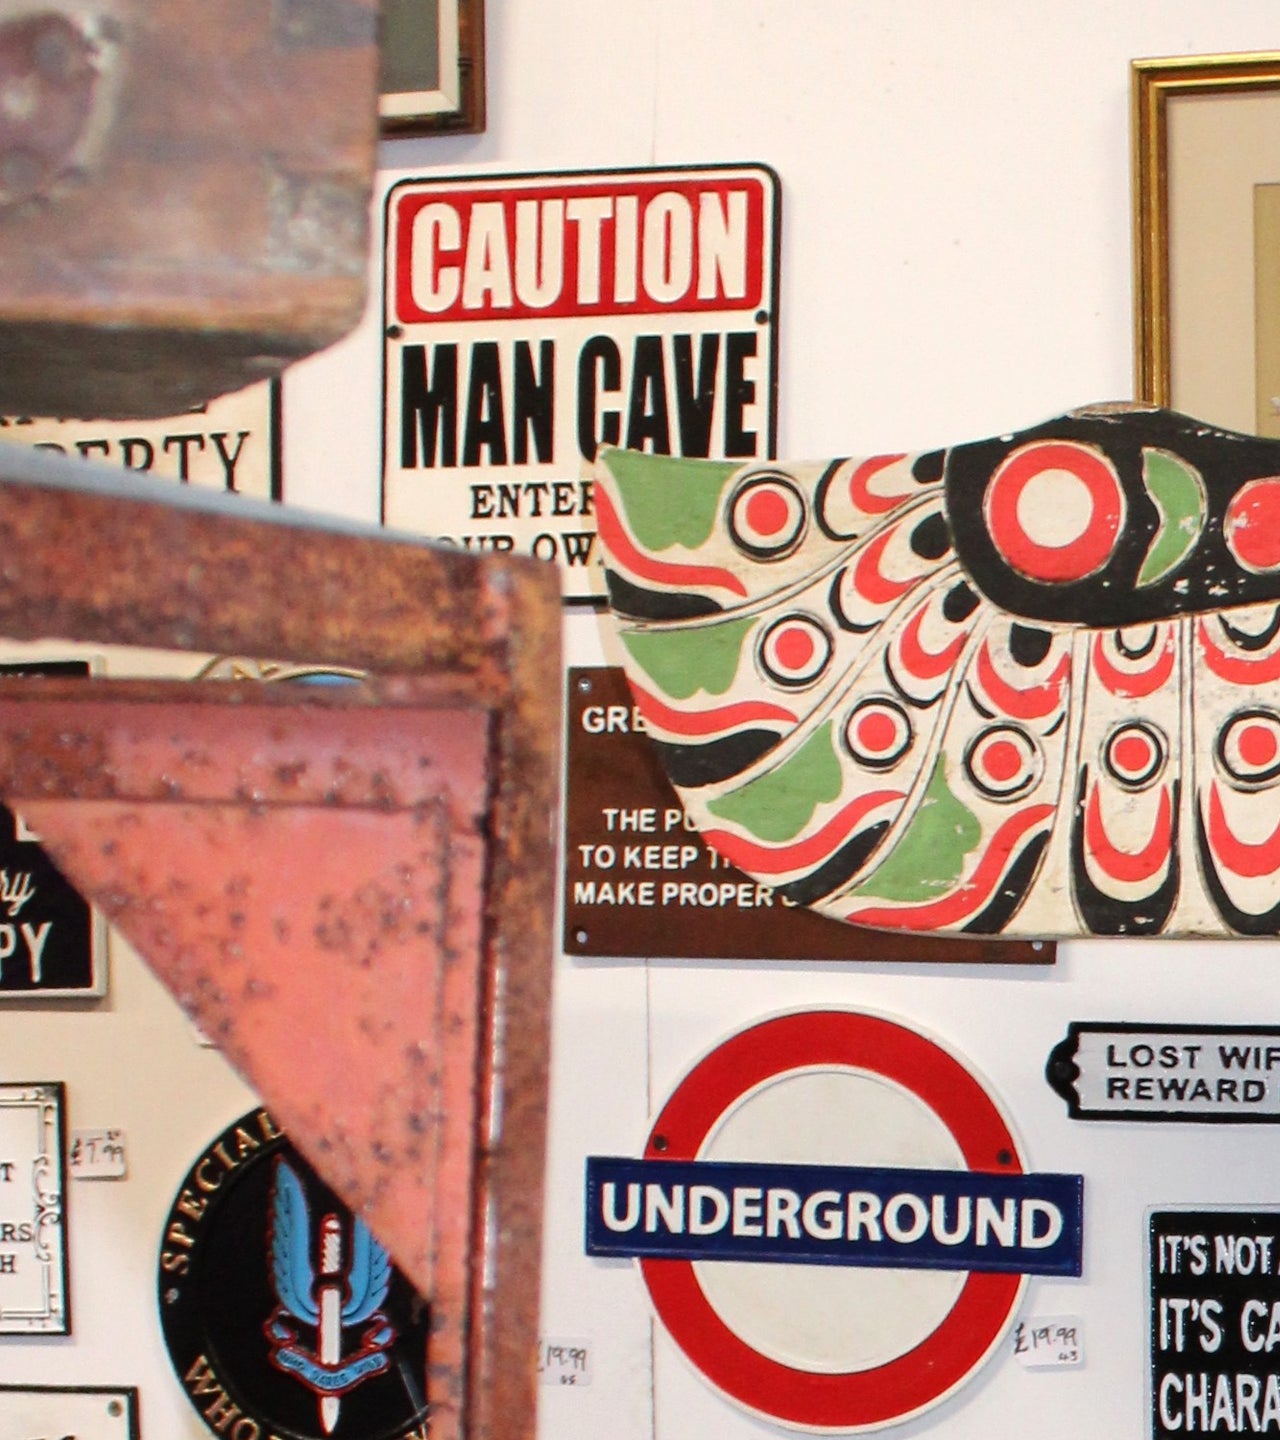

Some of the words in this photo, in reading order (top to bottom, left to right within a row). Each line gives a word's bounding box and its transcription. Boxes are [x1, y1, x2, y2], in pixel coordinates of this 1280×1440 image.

[411, 190, 748, 313] CAUTION
[401, 339, 554, 469] MAN
[577, 332, 757, 462] CAVE
[532, 531, 598, 568] OW
[582, 706, 650, 733] GRE
[602, 808, 655, 832] THE
[578, 845, 615, 869] TO
[624, 845, 698, 869] KEEP
[575, 882, 655, 906] MAKE
[662, 883, 773, 907] PROPER
[1106, 1044, 1201, 1070] LOST
[1106, 1077, 1266, 1103] REWARD
[161, 1111, 285, 1276] SPECIAL
[602, 1182, 1063, 1249] UNDERGROUND
[1159, 1235, 1208, 1275] IT'S
[1214, 1235, 1274, 1275] NOT
[1014, 1322, 1077, 1354] £19.99
[1159, 1298, 1223, 1353] IT'S
